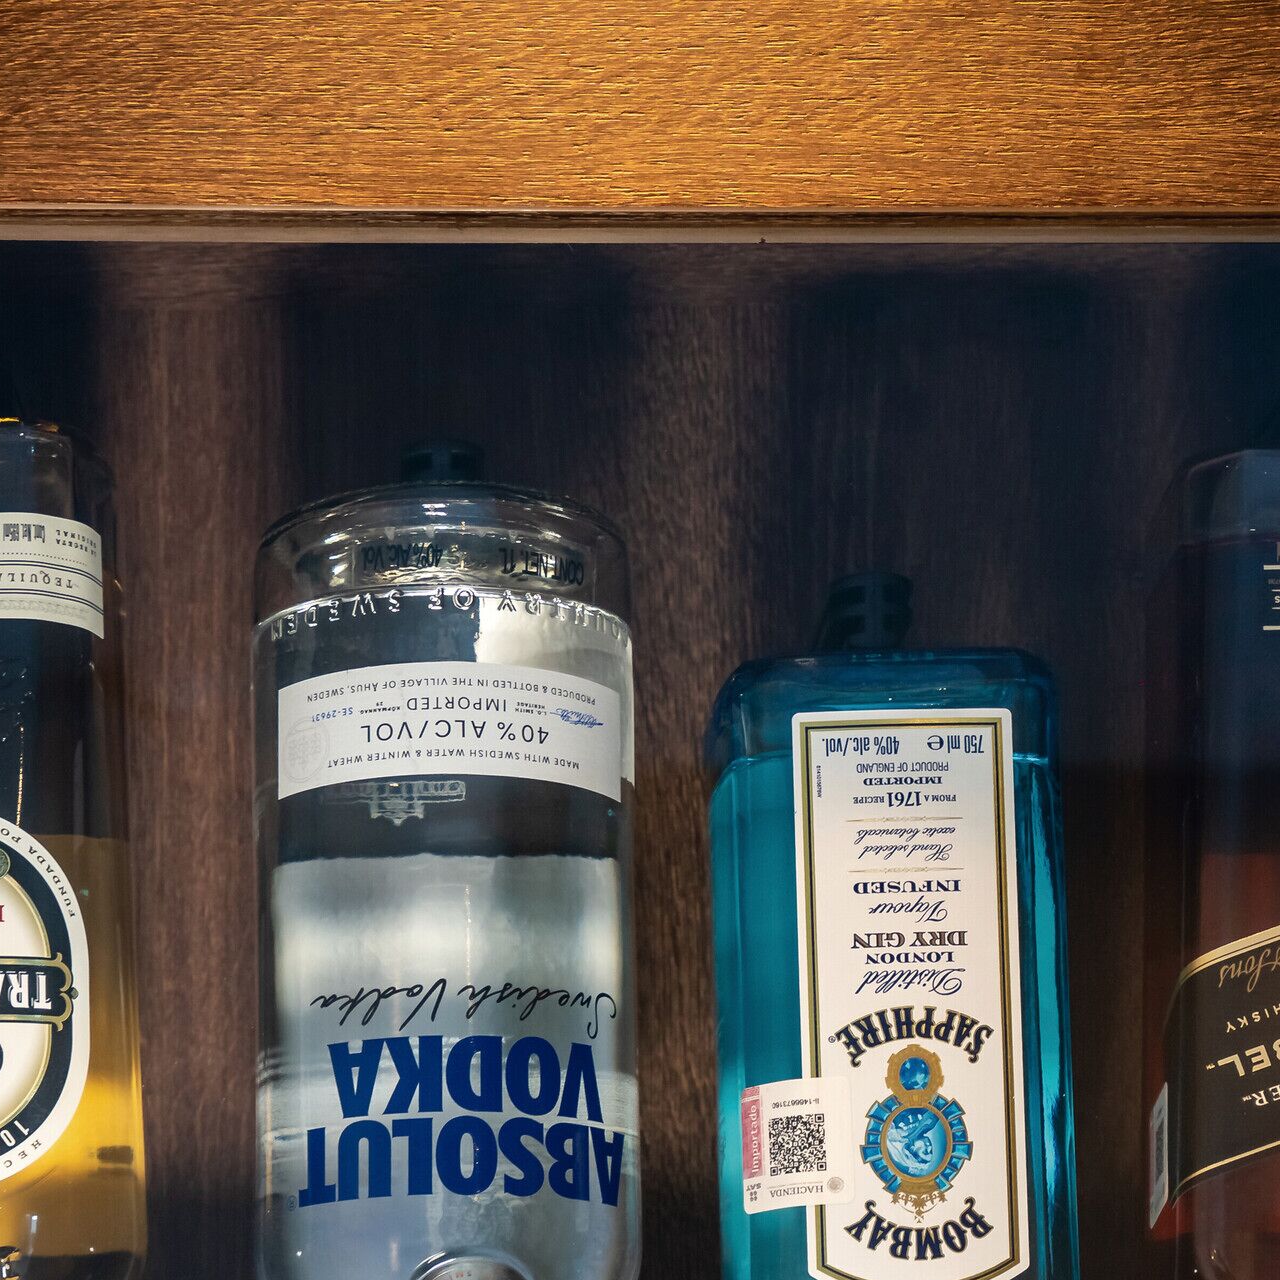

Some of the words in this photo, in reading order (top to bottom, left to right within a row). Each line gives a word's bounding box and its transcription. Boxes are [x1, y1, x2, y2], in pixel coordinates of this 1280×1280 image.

[428, 585, 474, 610] OF
[270, 589, 404, 641] SWEDEN
[347, 682, 379, 693] ÅHUS,
[382, 681, 396, 690] OF
[401, 678, 448, 688] VILLAGE
[452, 678, 473, 686] THE
[492, 680, 539, 692] BOTTLED
[307, 687, 344, 702] SWEDEN
[551, 687, 596, 705] PRODUCED
[406, 696, 507, 712] IMPORTED
[516, 701, 545, 710] HERITAGE
[360, 720, 486, 743] ALC/VOL
[497, 722, 549, 745] 40%
[821, 736, 870, 757] alc./vol.
[873, 736, 900, 755] 40%
[947, 735, 960, 754] ml
[964, 734, 985, 753] 750
[327, 755, 363, 768] WHEAT
[367, 750, 411, 762] WINTER
[415, 749, 422, 758] &
[426, 749, 465, 758] WATER
[469, 749, 520, 760] SWEDISH
[524, 753, 550, 765] WITH
[554, 758, 580, 770] MADE
[856, 762, 895, 773] ENGLAND
[897, 762, 908, 772] OF
[910, 761, 949, 772] PRODUCT
[863, 776, 943, 786] IMPORTED
[853, 795, 885, 804] RECIPE
[886, 791, 922, 807] 1761
[924, 794, 930, 803] A
[931, 794, 957, 803] FROM
[854, 827, 920, 845] botanicals
[923, 827, 956, 841] exotic
[858, 844, 910, 860] selected
[910, 843, 953, 862] Hand
[28, 845, 77, 918] FUNDADA
[853, 879, 961, 895] INFUSED
[868, 895, 948, 923] Vapour
[851, 931, 905, 949] GIN
[910, 930, 968, 948] DRY
[865, 951, 954, 965] LONDON
[855, 968, 966, 996] Distilled
[309, 978, 448, 1032] Vodka
[458, 982, 617, 1040] Swedish
[834, 1006, 994, 1068] SAPPHIRE
[327, 1035, 604, 1124] VODKA
[748, 1105, 760, 1173] Importado
[298, 1116, 625, 1208] ABSOLUT
[746, 1182, 761, 1191] SAT
[769, 1185, 824, 1198] HACIENDA
[843, 1197, 994, 1261] BOMBAY
